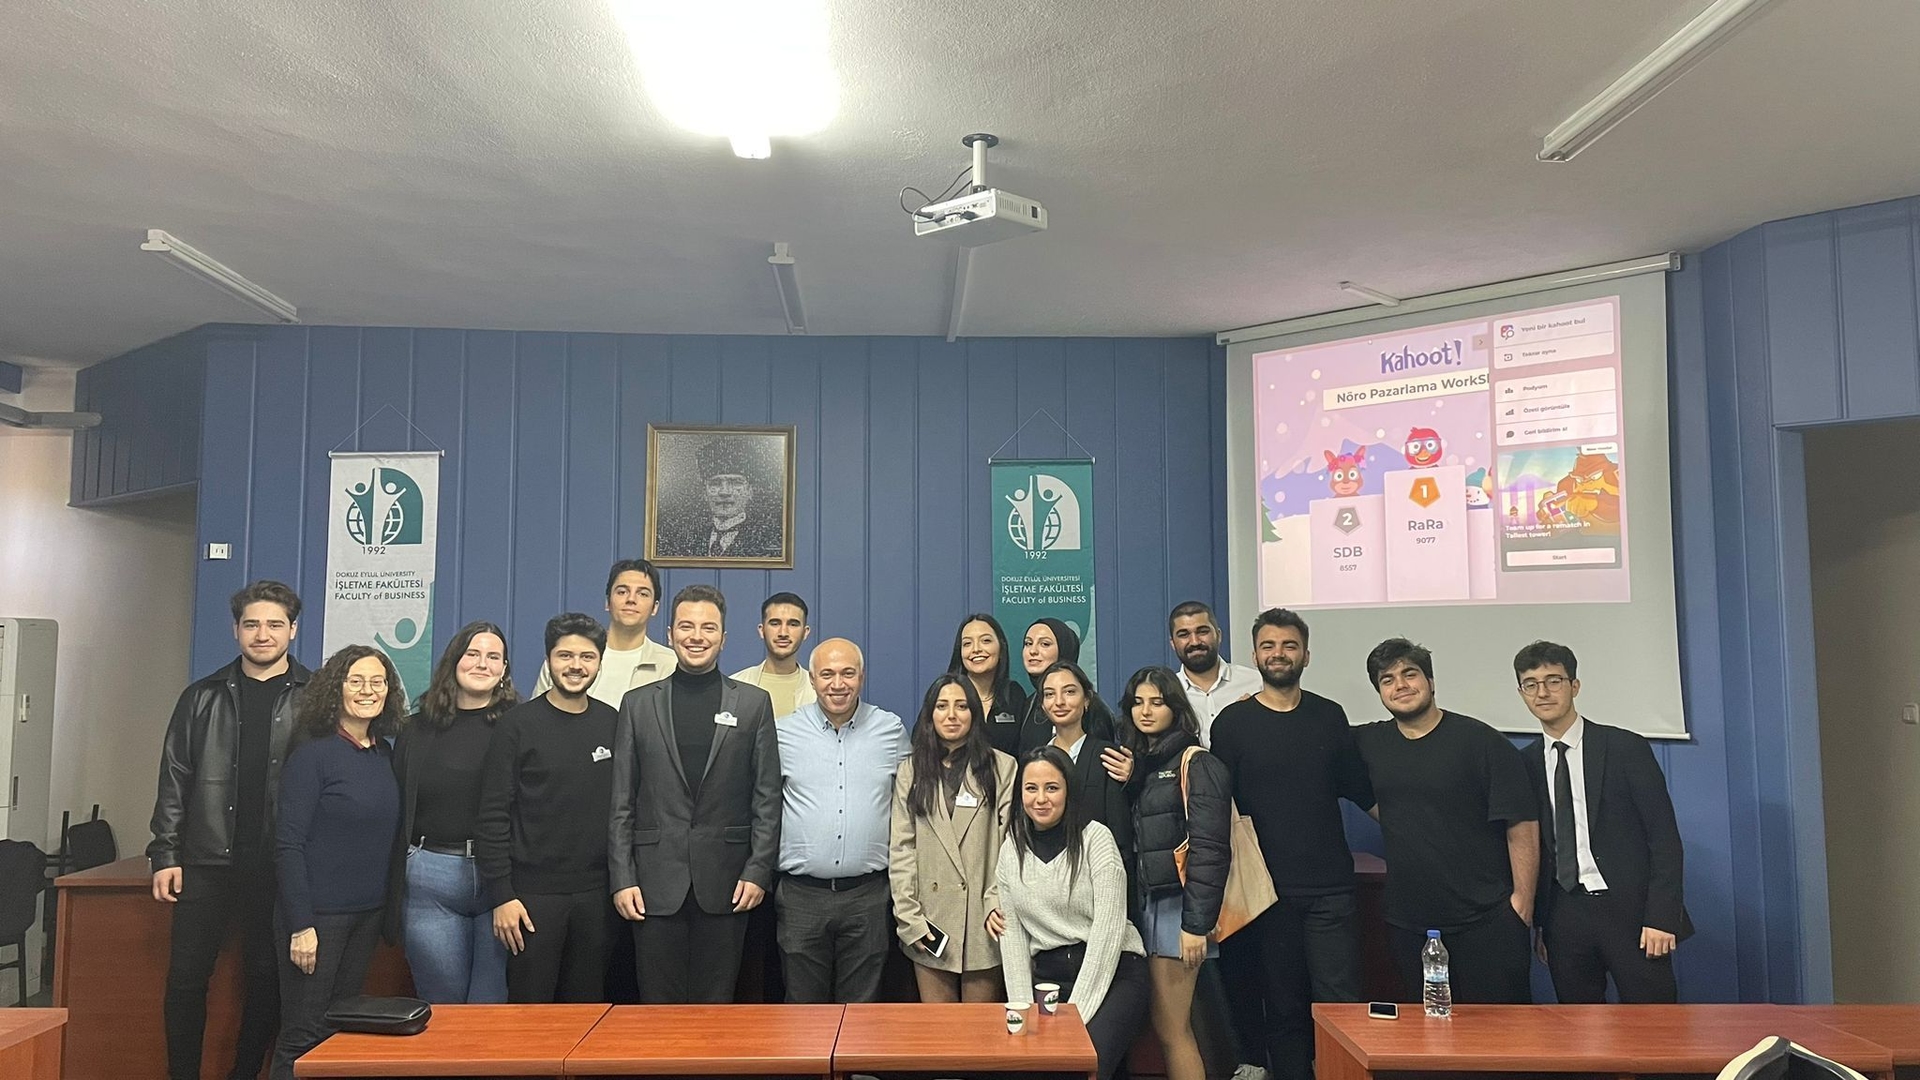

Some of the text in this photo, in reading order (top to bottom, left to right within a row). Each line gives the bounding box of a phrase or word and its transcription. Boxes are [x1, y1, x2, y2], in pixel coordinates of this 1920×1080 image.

[1380, 338, 1463, 374] Kahoot!
[1370, 380, 1438, 399] Pazarlama
[1419, 485, 1428, 498] 1
[1342, 512, 1353, 526] 2
[1408, 518, 1444, 531] RaRa
[362, 546, 386, 555] 1992
[1024, 551, 1047, 559] 1992
[1333, 546, 1363, 558] SDB
[335, 578, 423, 590] İŞLETME FAKÜLTESİ
[1001, 582, 1084, 595] İŞLETME FAKÜLTESİ
[334, 591, 426, 600] FACULTY of BUSINESS
[1001, 595, 1087, 604] FACULTY of BUSINESS
